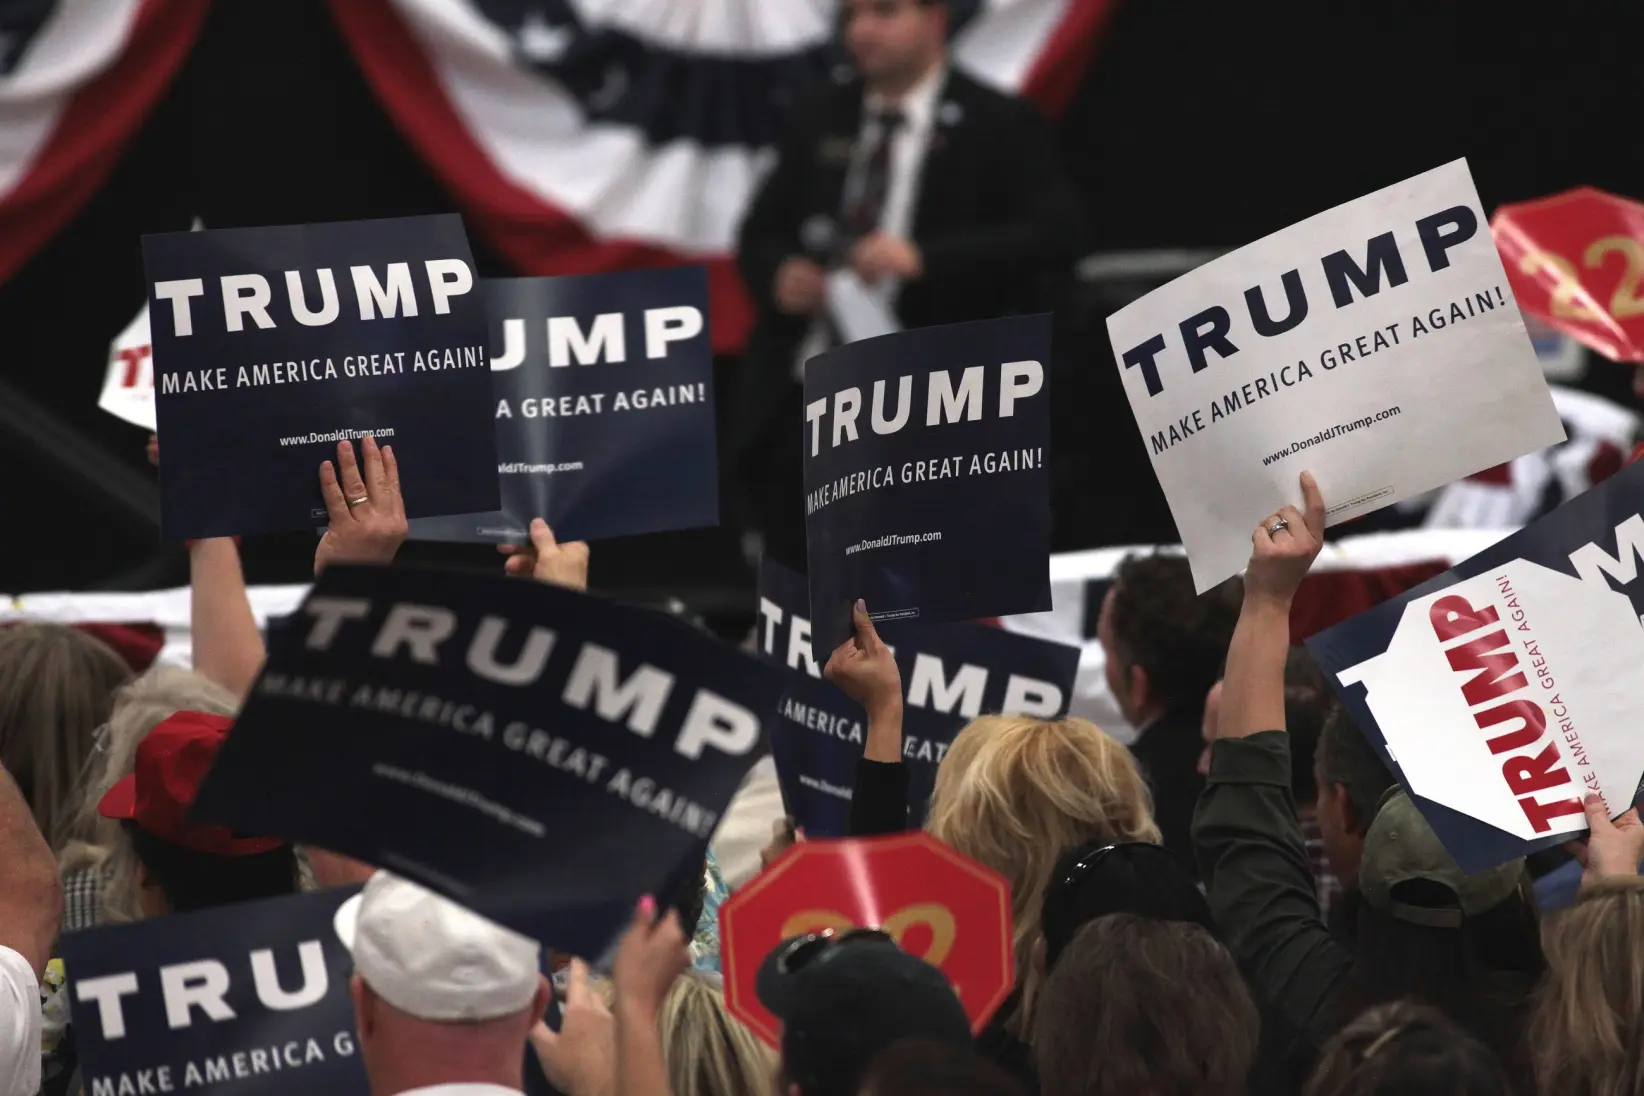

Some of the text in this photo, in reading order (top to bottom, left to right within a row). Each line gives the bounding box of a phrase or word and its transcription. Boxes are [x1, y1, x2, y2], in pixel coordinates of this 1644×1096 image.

[154, 258, 473, 337] TRUMP
[1121, 204, 1478, 398] TRUMP
[161, 345, 484, 394] MAKE AMERICA GREAT AGAIN!
[521, 394, 605, 418] GREAT
[613, 383, 705, 412] AGAIN!
[1150, 285, 1506, 455] MAKE AMERICA GREAT AGAIN!
[280, 427, 395, 446] www.DonaldJTrump.com
[806, 360, 1044, 458] TRUMP
[1262, 405, 1402, 467] www.DonaldJTrump.com
[807, 447, 1043, 515] MAKE AMERICA GREAT AGAIN!
[845, 530, 942, 556] www.DonaldJTrump.com
[1495, 574, 1532, 633] AGAIN!
[303, 599, 760, 759] TRUMP
[760, 597, 1062, 721] TRMP
[1524, 639, 1556, 690] GREAT
[352, 684, 494, 740] AMERICA
[503, 721, 608, 784] GREAT
[784, 698, 949, 764] AMERICA EAT
[1429, 594, 1586, 834] TRUMP
[1549, 693, 1591, 766] AMERICA
[76, 939, 329, 1040] TRU
[92, 1066, 175, 1096] MAKE
[184, 1038, 325, 1087] AMERICA
